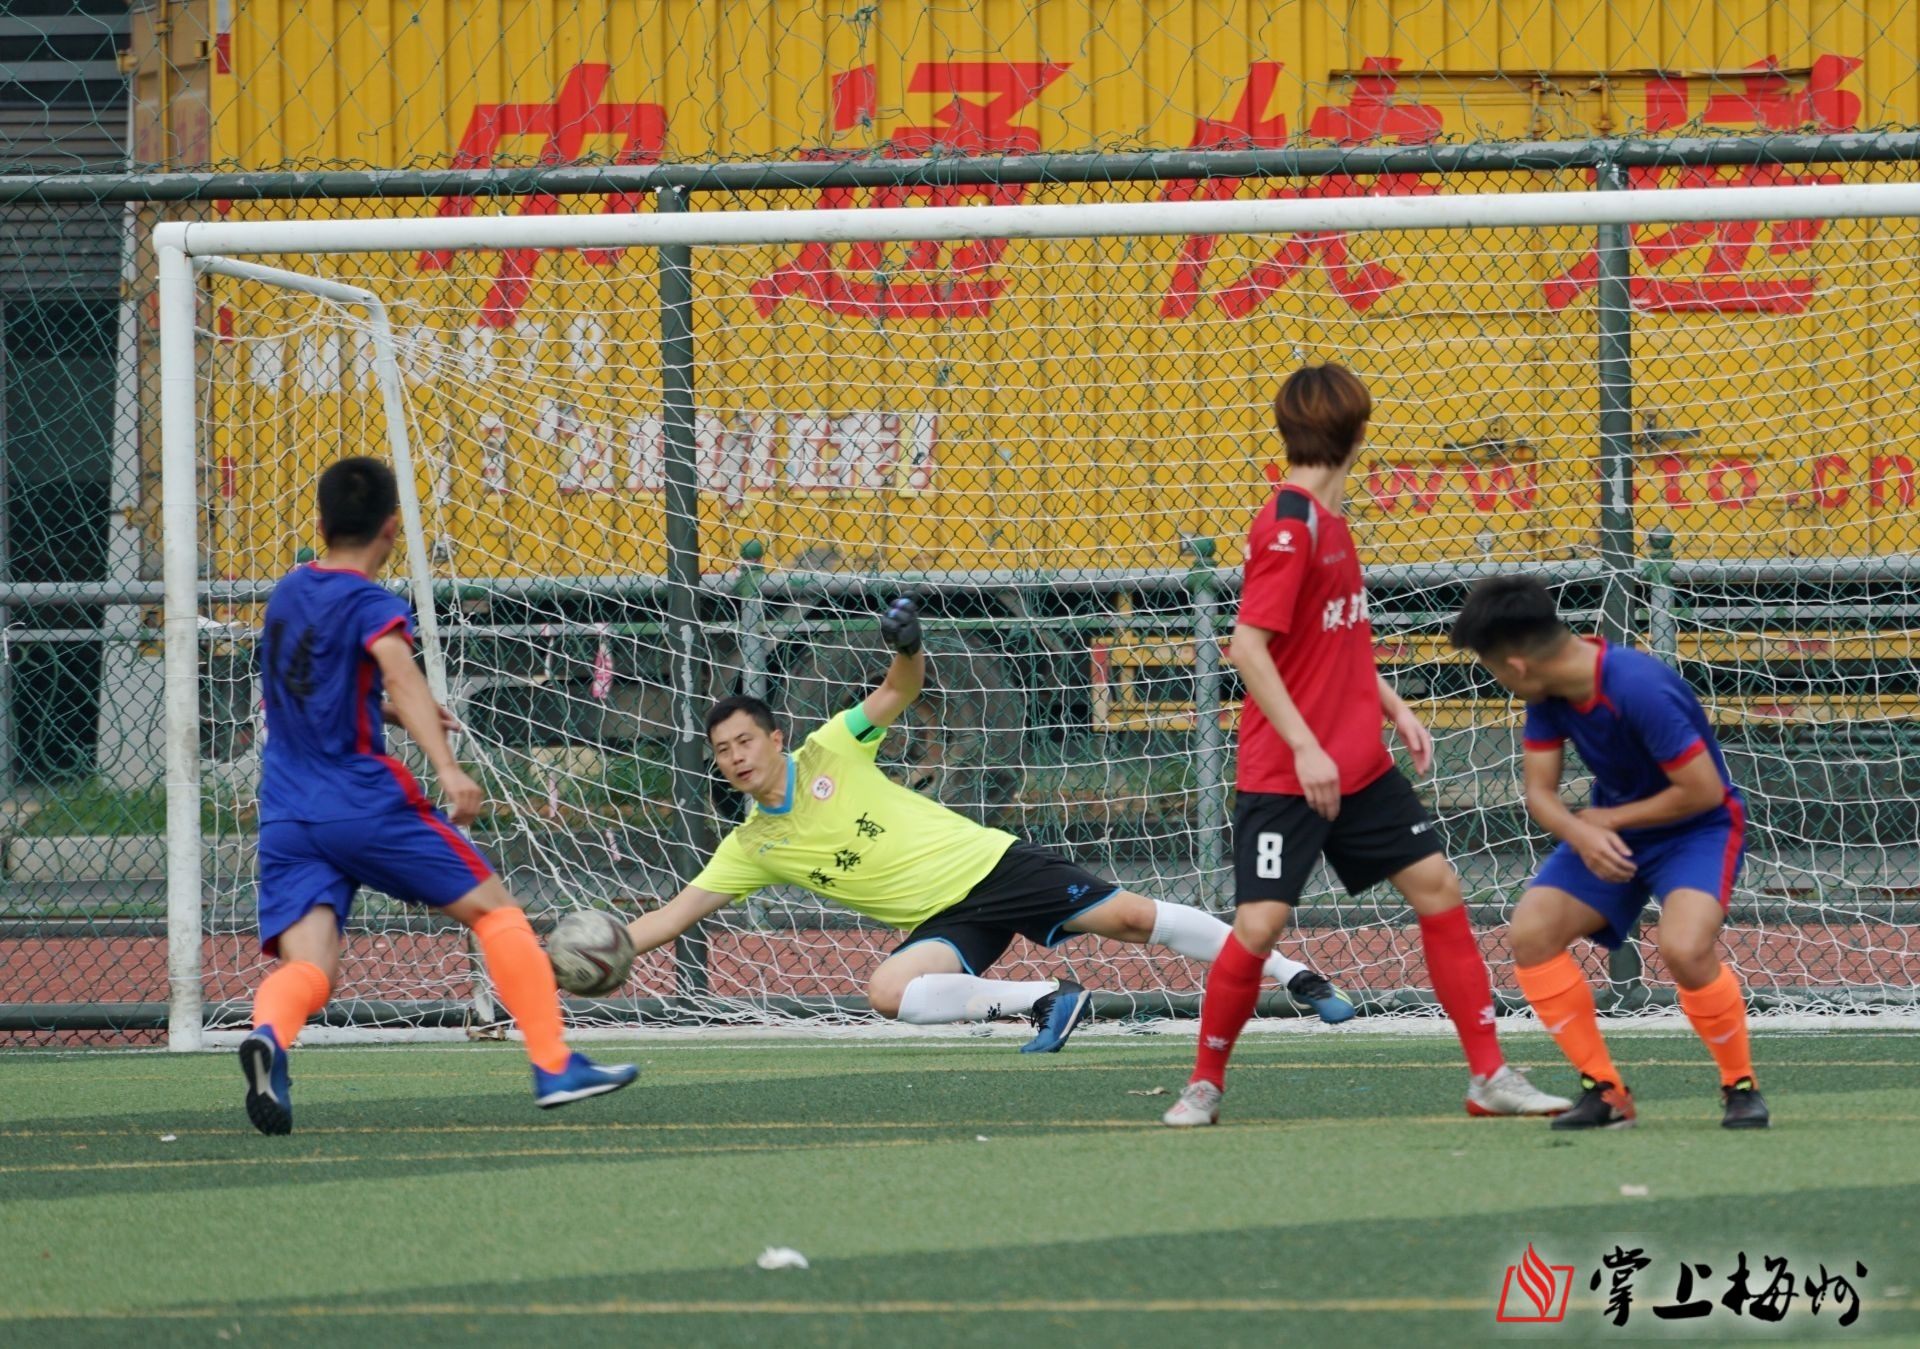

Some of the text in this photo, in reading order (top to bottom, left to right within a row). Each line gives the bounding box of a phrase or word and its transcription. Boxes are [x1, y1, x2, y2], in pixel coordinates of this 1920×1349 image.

[417, 54, 1863, 328] 中通快递
[1256, 832, 1283, 879] 8
